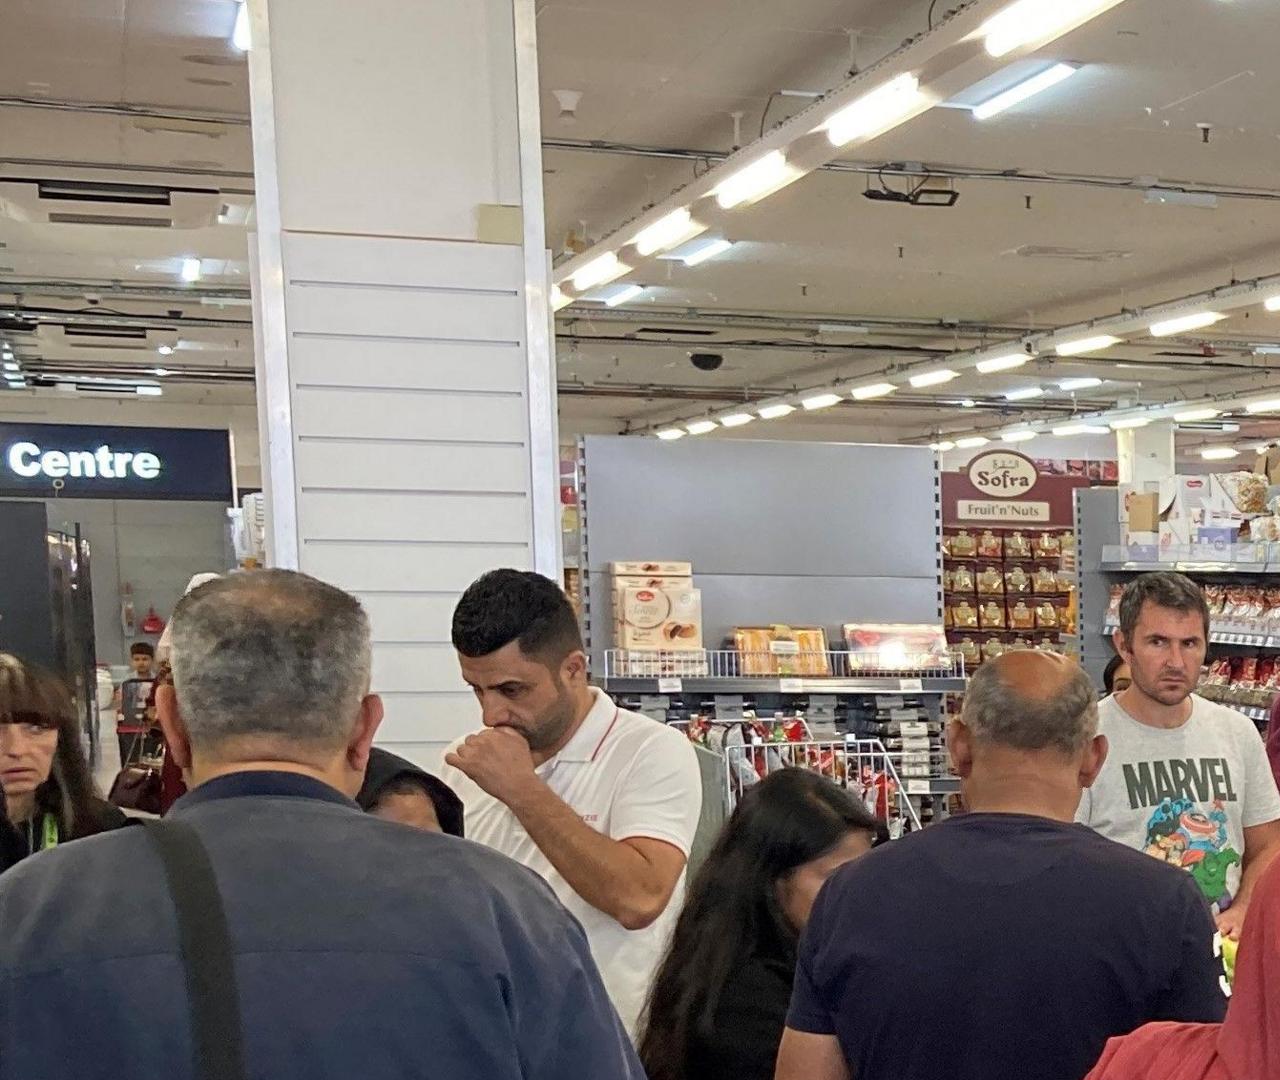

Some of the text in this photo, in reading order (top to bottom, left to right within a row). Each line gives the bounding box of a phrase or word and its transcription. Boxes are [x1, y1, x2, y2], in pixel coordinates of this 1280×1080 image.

[9, 441, 162, 480] Centre
[977, 471, 1030, 489] Sofra
[1122, 757, 1238, 810] MARVEL
